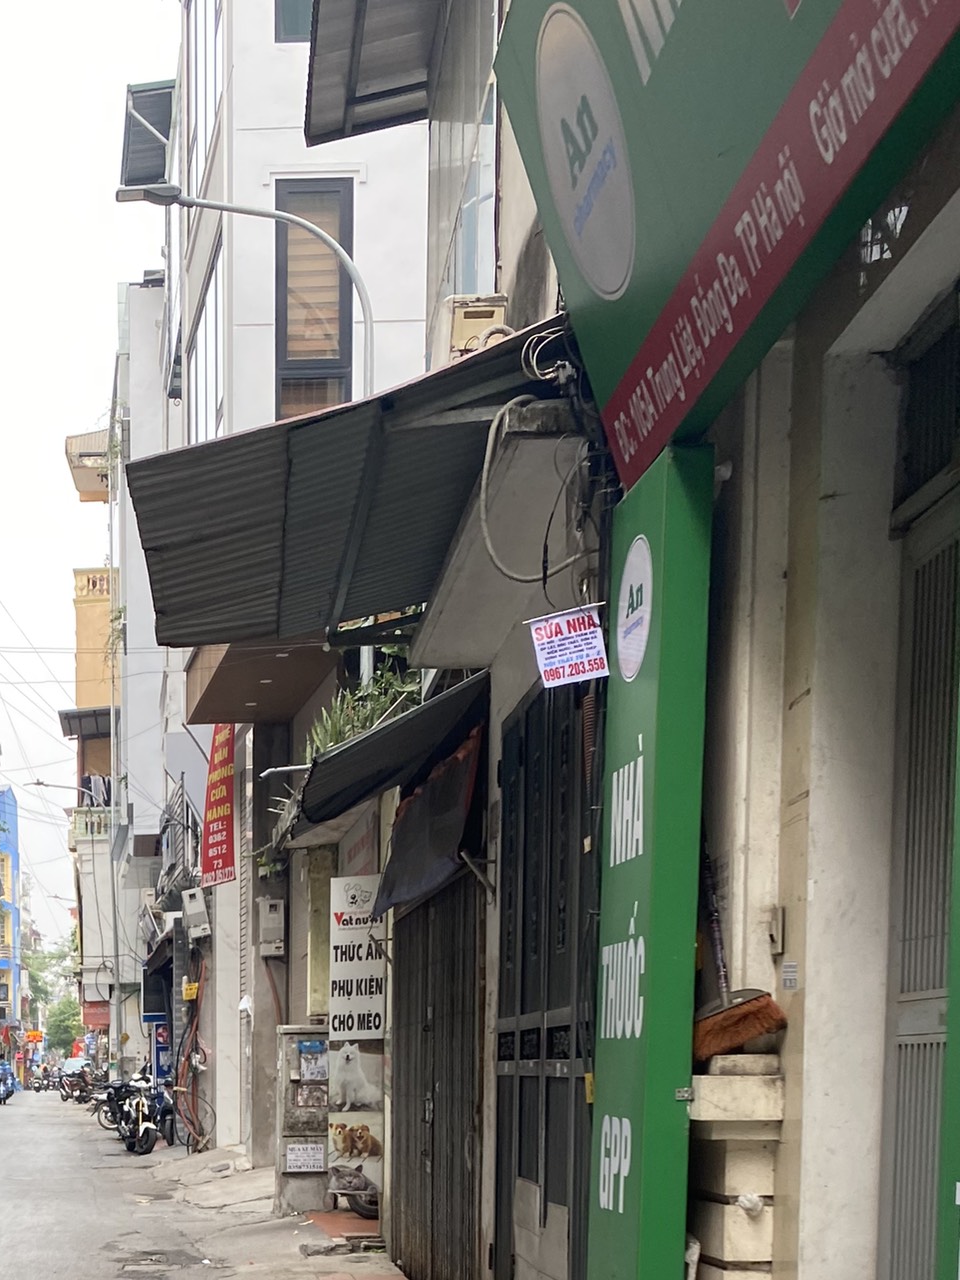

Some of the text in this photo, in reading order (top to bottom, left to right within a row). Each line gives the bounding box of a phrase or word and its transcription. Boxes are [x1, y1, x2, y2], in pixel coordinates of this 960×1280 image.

[734, 209, 762, 277] TP
[750, 181, 784, 255] Hà
[534, 620, 564, 642] SỬA
[566, 611, 597, 635] NHÀ
[543, 656, 606, 682] 0967.203.558
[206, 803, 231, 822] HÀNG
[610, 733, 644, 867] NHÀ
[209, 821, 227, 833] TEL:
[212, 859, 222, 869] 73
[333, 941, 363, 963] THỨC
[601, 900, 645, 1040] THUỐC
[331, 974, 383, 1000] PHỤ KIỆN
[332, 1009, 382, 1032] CHÓ MÈO
[599, 1114, 632, 1214] GPP
